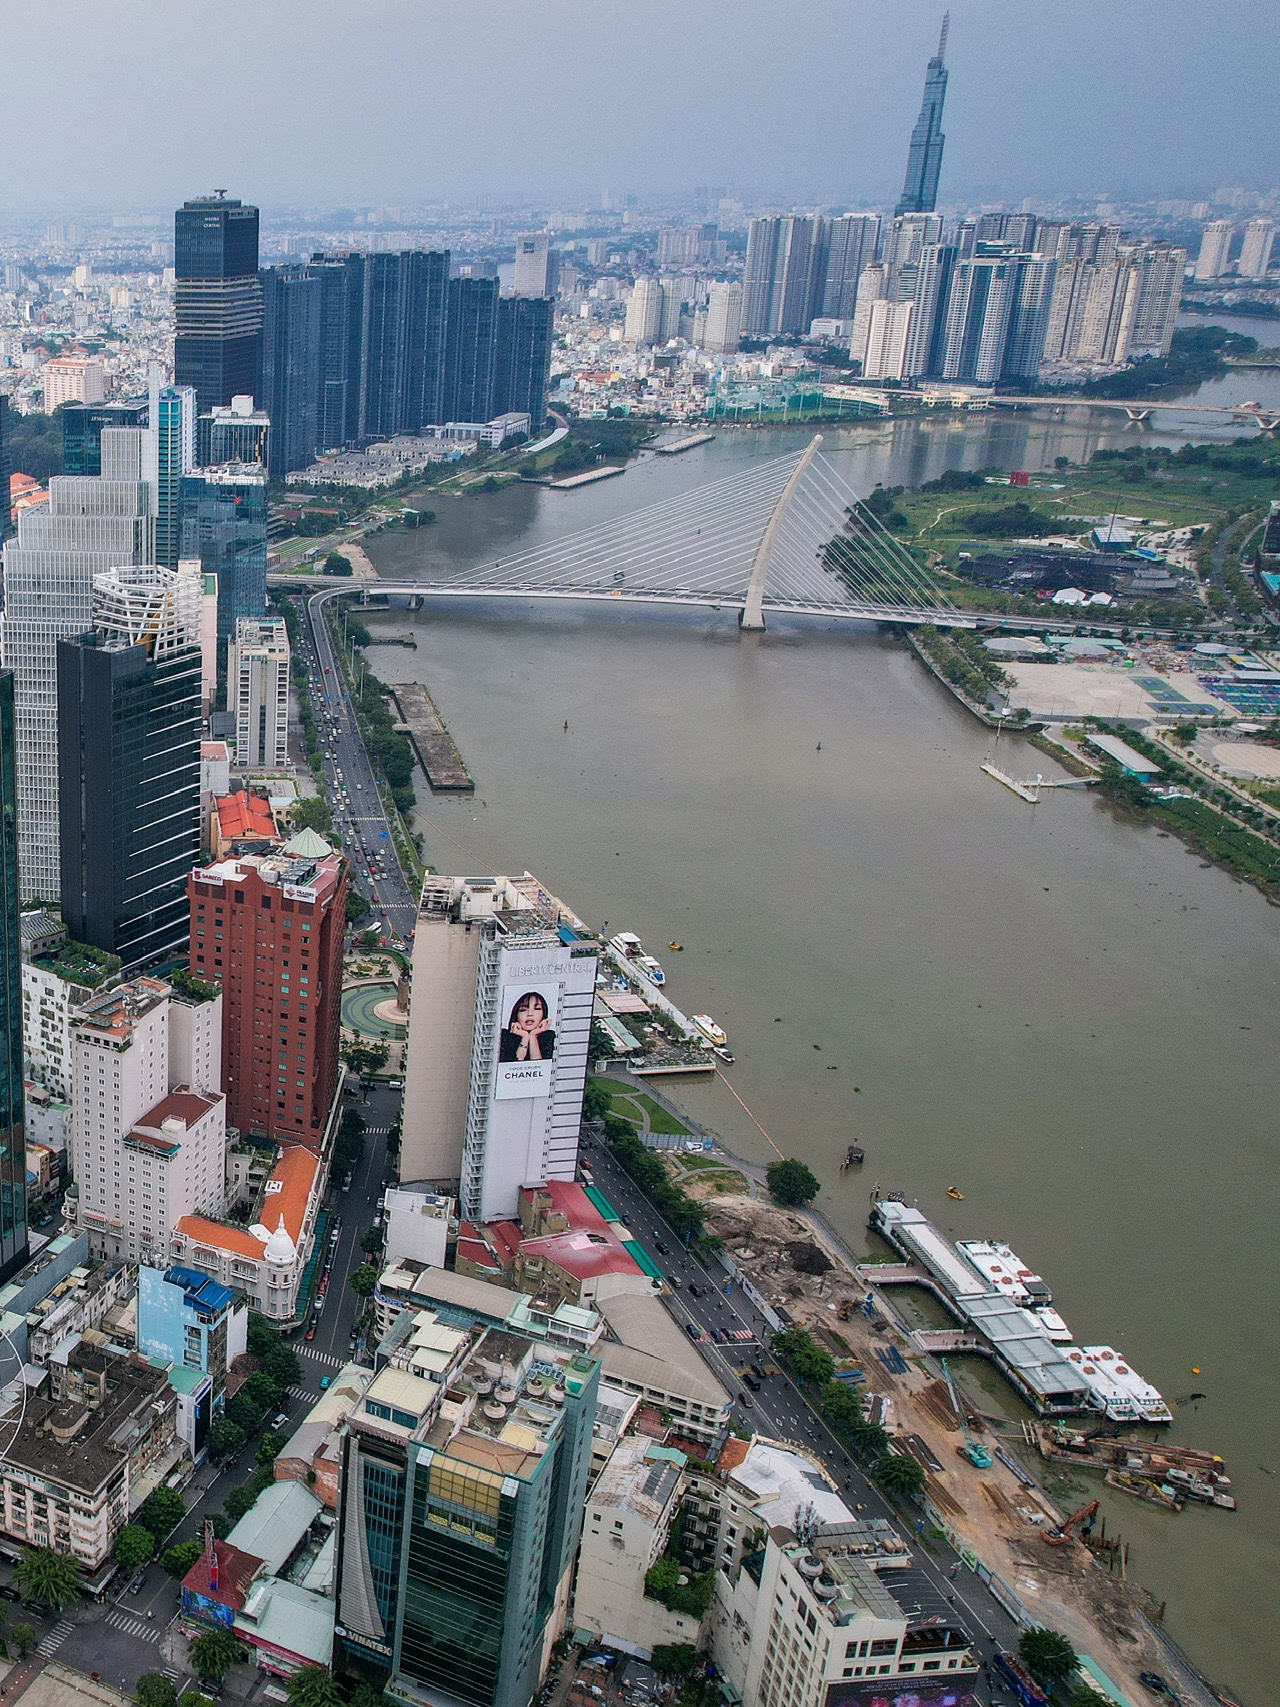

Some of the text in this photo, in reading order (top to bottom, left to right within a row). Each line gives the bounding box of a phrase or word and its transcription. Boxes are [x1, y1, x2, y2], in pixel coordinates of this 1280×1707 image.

[510, 962, 592, 977] LIBERTY CENTRAL
[504, 1071, 544, 1080] CHANEL
[348, 1631, 393, 1657] VINATEX
